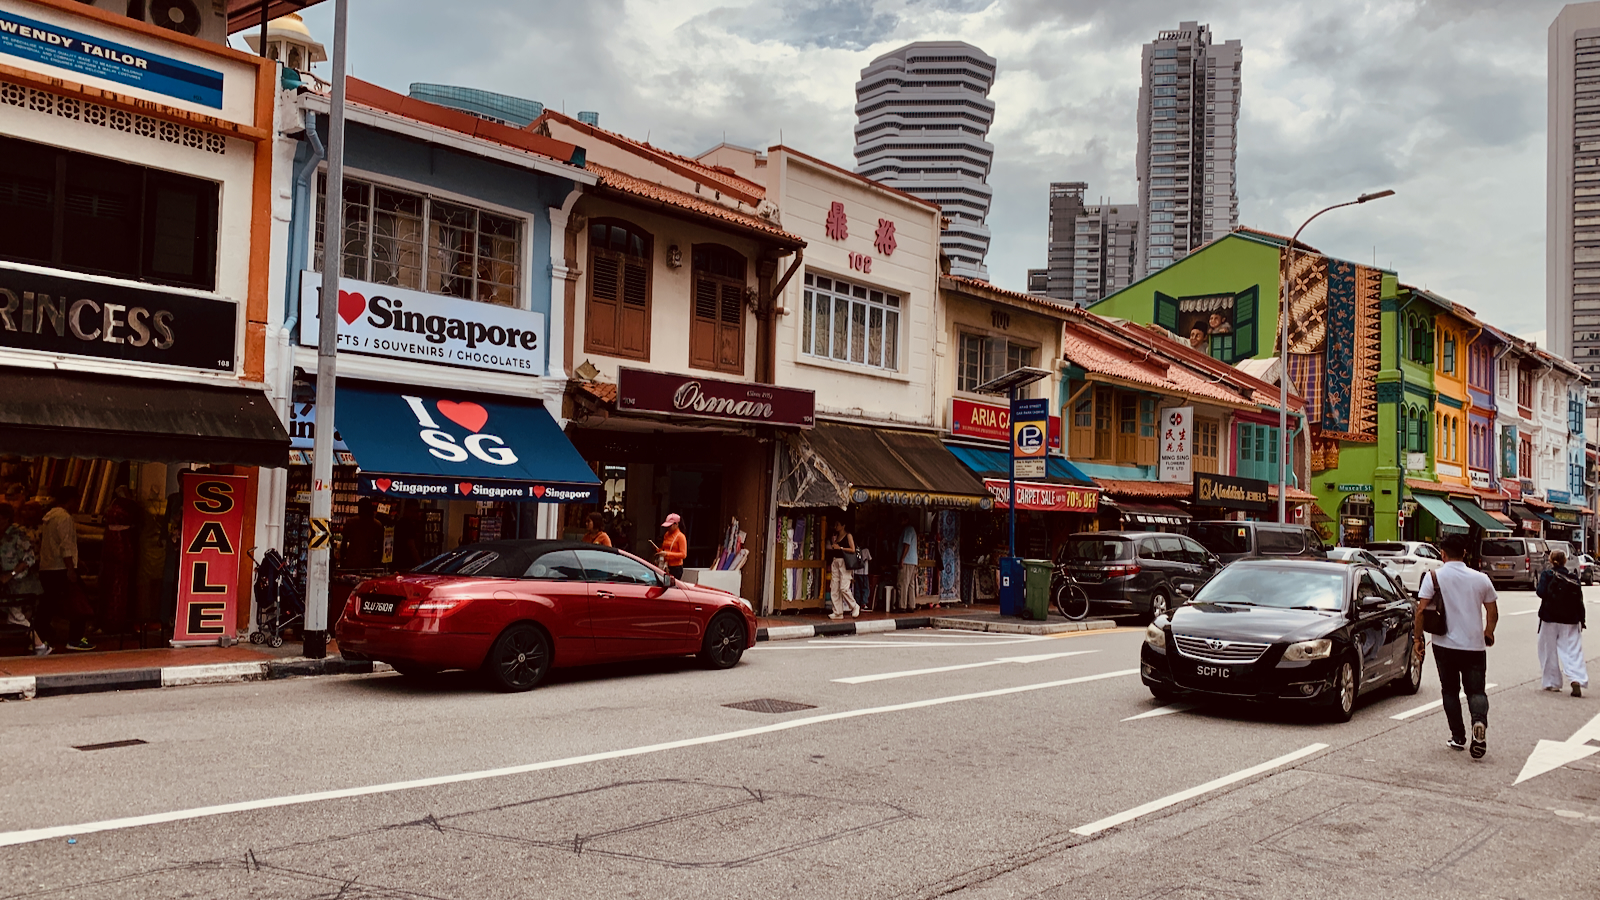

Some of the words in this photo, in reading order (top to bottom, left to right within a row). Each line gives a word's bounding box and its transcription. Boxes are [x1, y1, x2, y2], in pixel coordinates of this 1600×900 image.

[0, 20, 73, 48] WENDY
[81, 42, 148, 69] TAILOR
[848, 251, 872, 274] 102
[367, 296, 538, 351] Singapore
[217, 359, 230, 368] 108
[337, 334, 359, 346] FTS
[373, 339, 444, 357] SOUVENIRS
[457, 350, 531, 369] CHOCOLATES
[401, 395, 440, 429] I
[673, 381, 774, 418] Osman
[971, 407, 997, 428] ARIA
[419, 429, 519, 465] SG
[371, 480, 377, 490] I
[391, 480, 447, 495] Singapore
[454, 484, 459, 494] I
[472, 484, 523, 498] Singapore
[529, 487, 533, 497] I
[545, 487, 590, 500] Singapore
[1016, 488, 1040, 505] CARPET
[1040, 490, 1056, 506] SALE
[1056, 494, 1062, 503] up
[1066, 491, 1082, 508] 70%
[1083, 492, 1097, 509] OFF
[1211, 481, 1245, 501] Aladdin's
[186, 480, 235, 635] SALE
